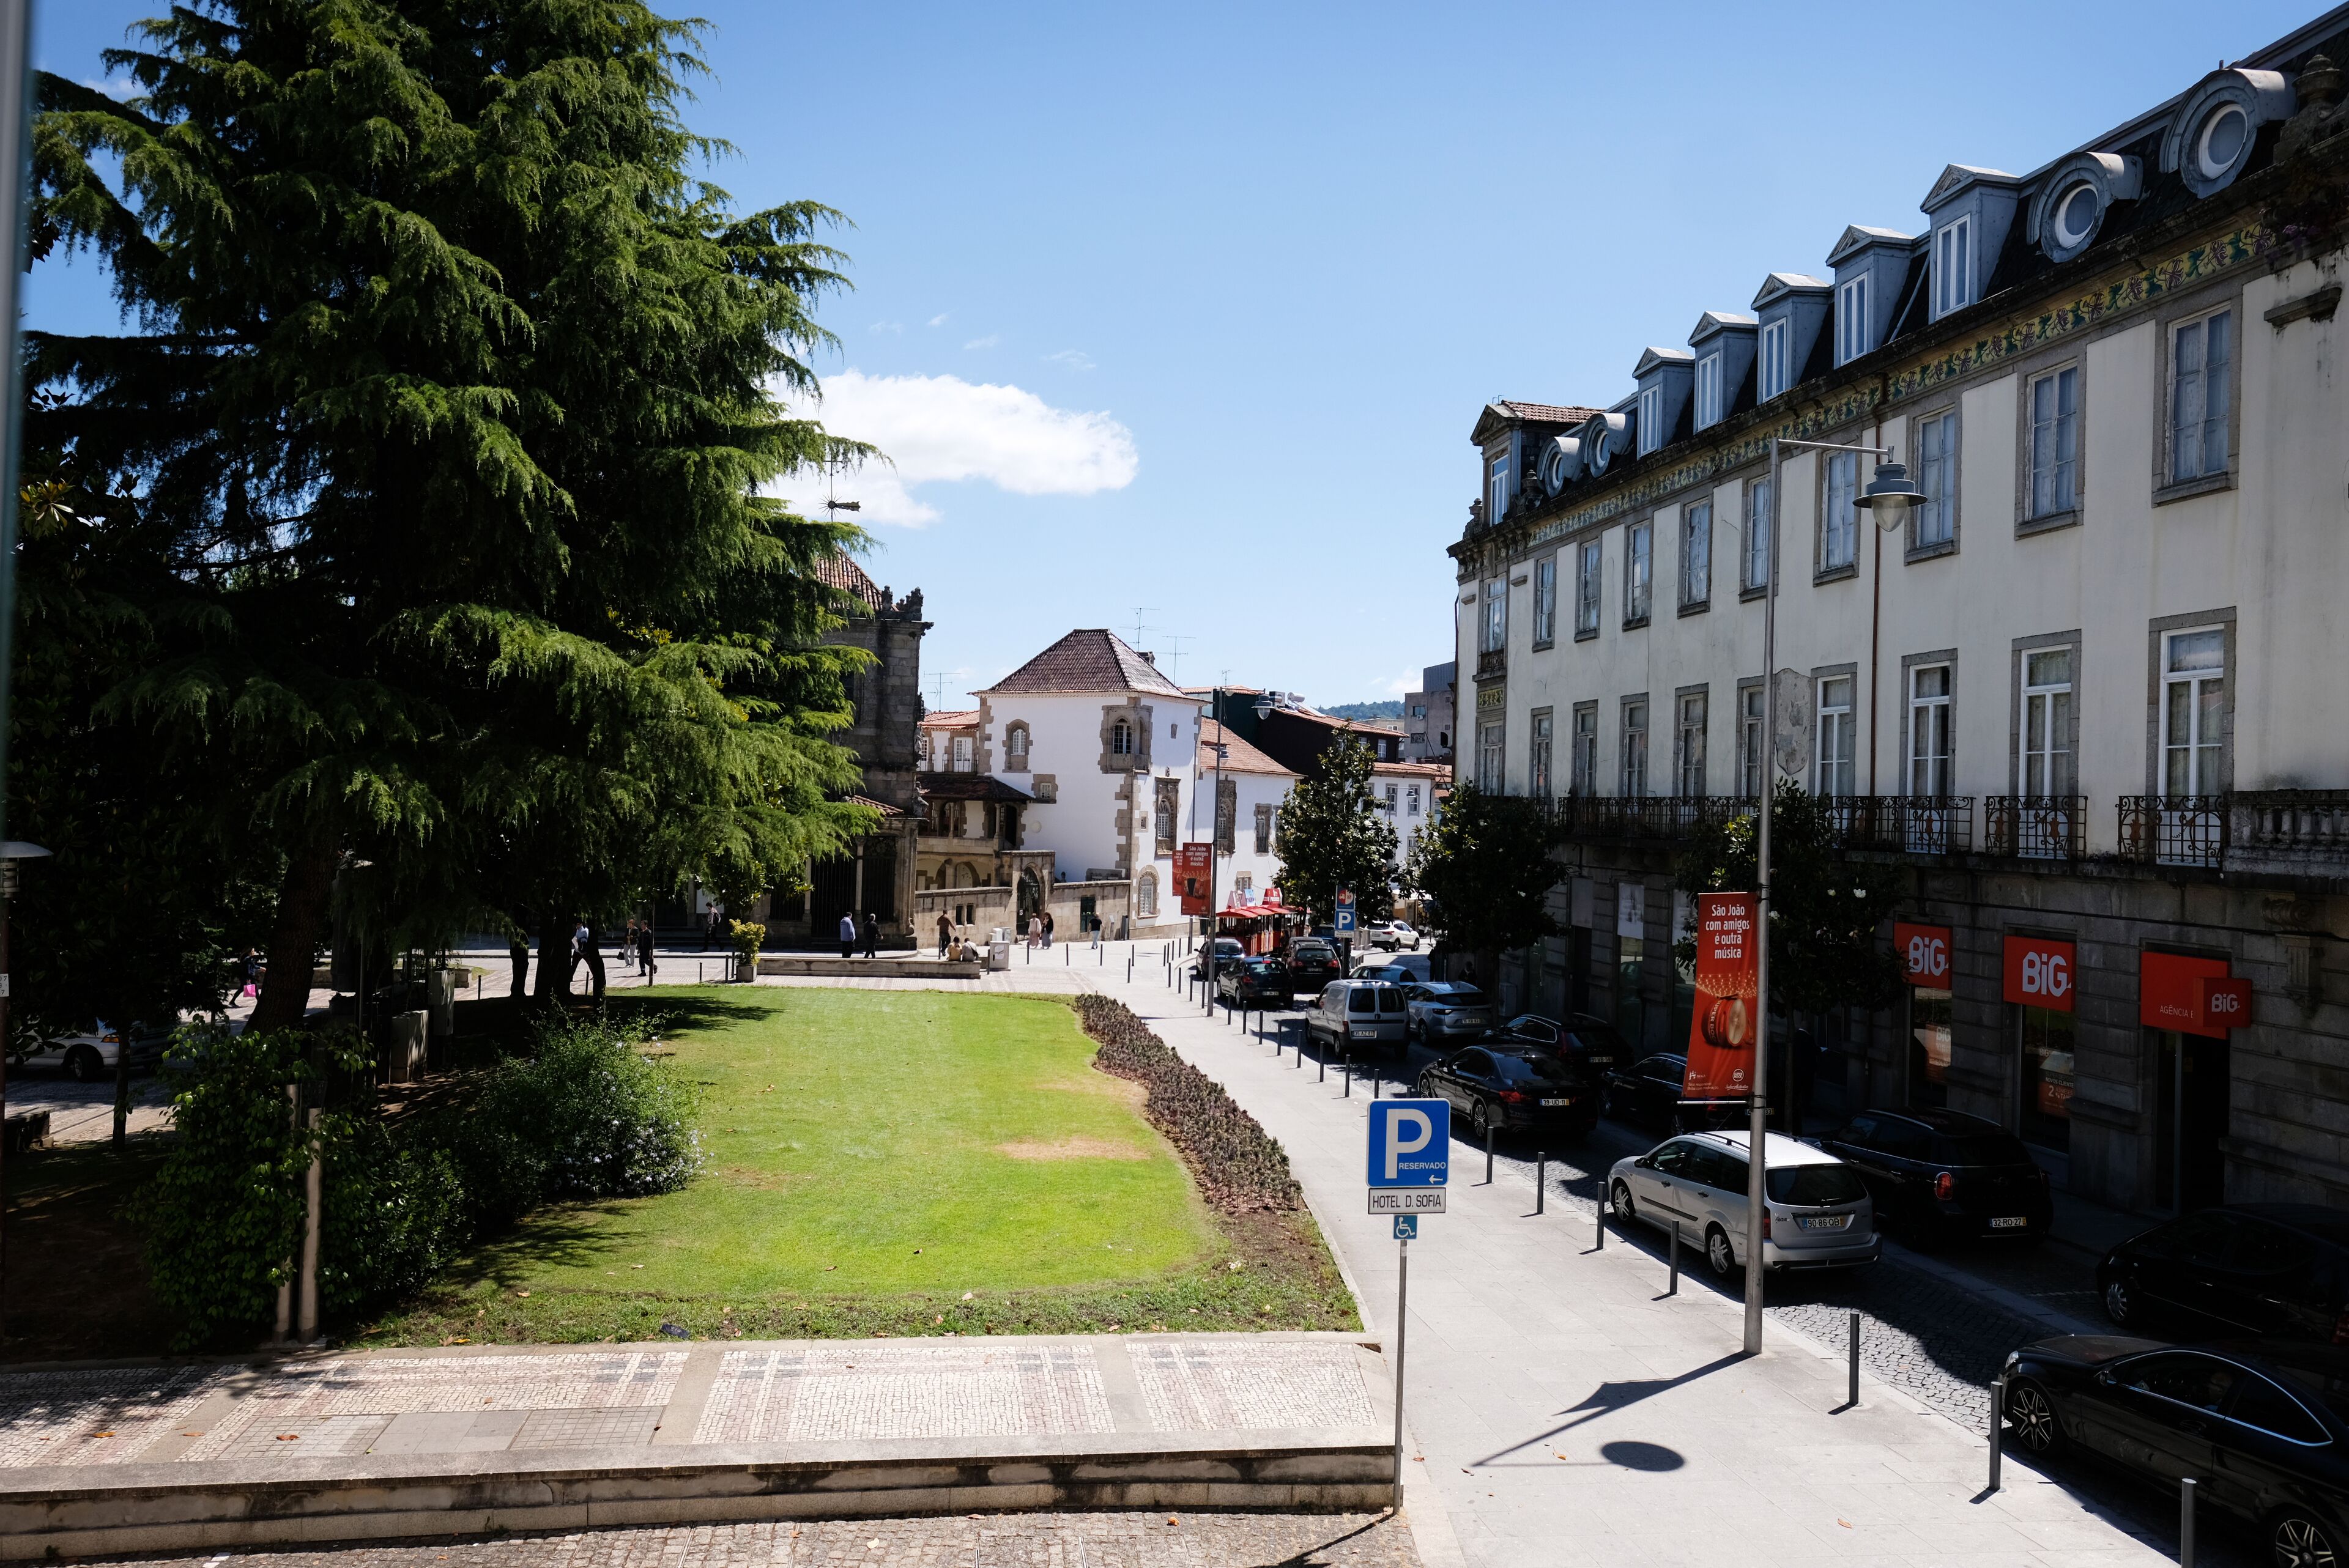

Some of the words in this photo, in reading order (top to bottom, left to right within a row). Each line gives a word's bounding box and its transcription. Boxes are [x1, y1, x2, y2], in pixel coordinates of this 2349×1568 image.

[1712, 904, 1726, 916] São
[1727, 904, 1745, 916] João
[1338, 912, 1351, 929] P
[1705, 920, 1721, 931] com
[1723, 918, 1750, 933] amigos
[1715, 933, 1720, 945] é
[1721, 932, 1742, 944] outra
[1715, 947, 1742, 959] música
[2159, 1004, 2189, 1018] AGÊNCIA
[2048, 1085, 2055, 1097] 2
[1385, 1108, 1432, 1179] P
[1373, 1195, 1401, 1208] HOTEL
[1405, 1195, 1414, 1207] D.
[1416, 1194, 1441, 1207] SOFIA
